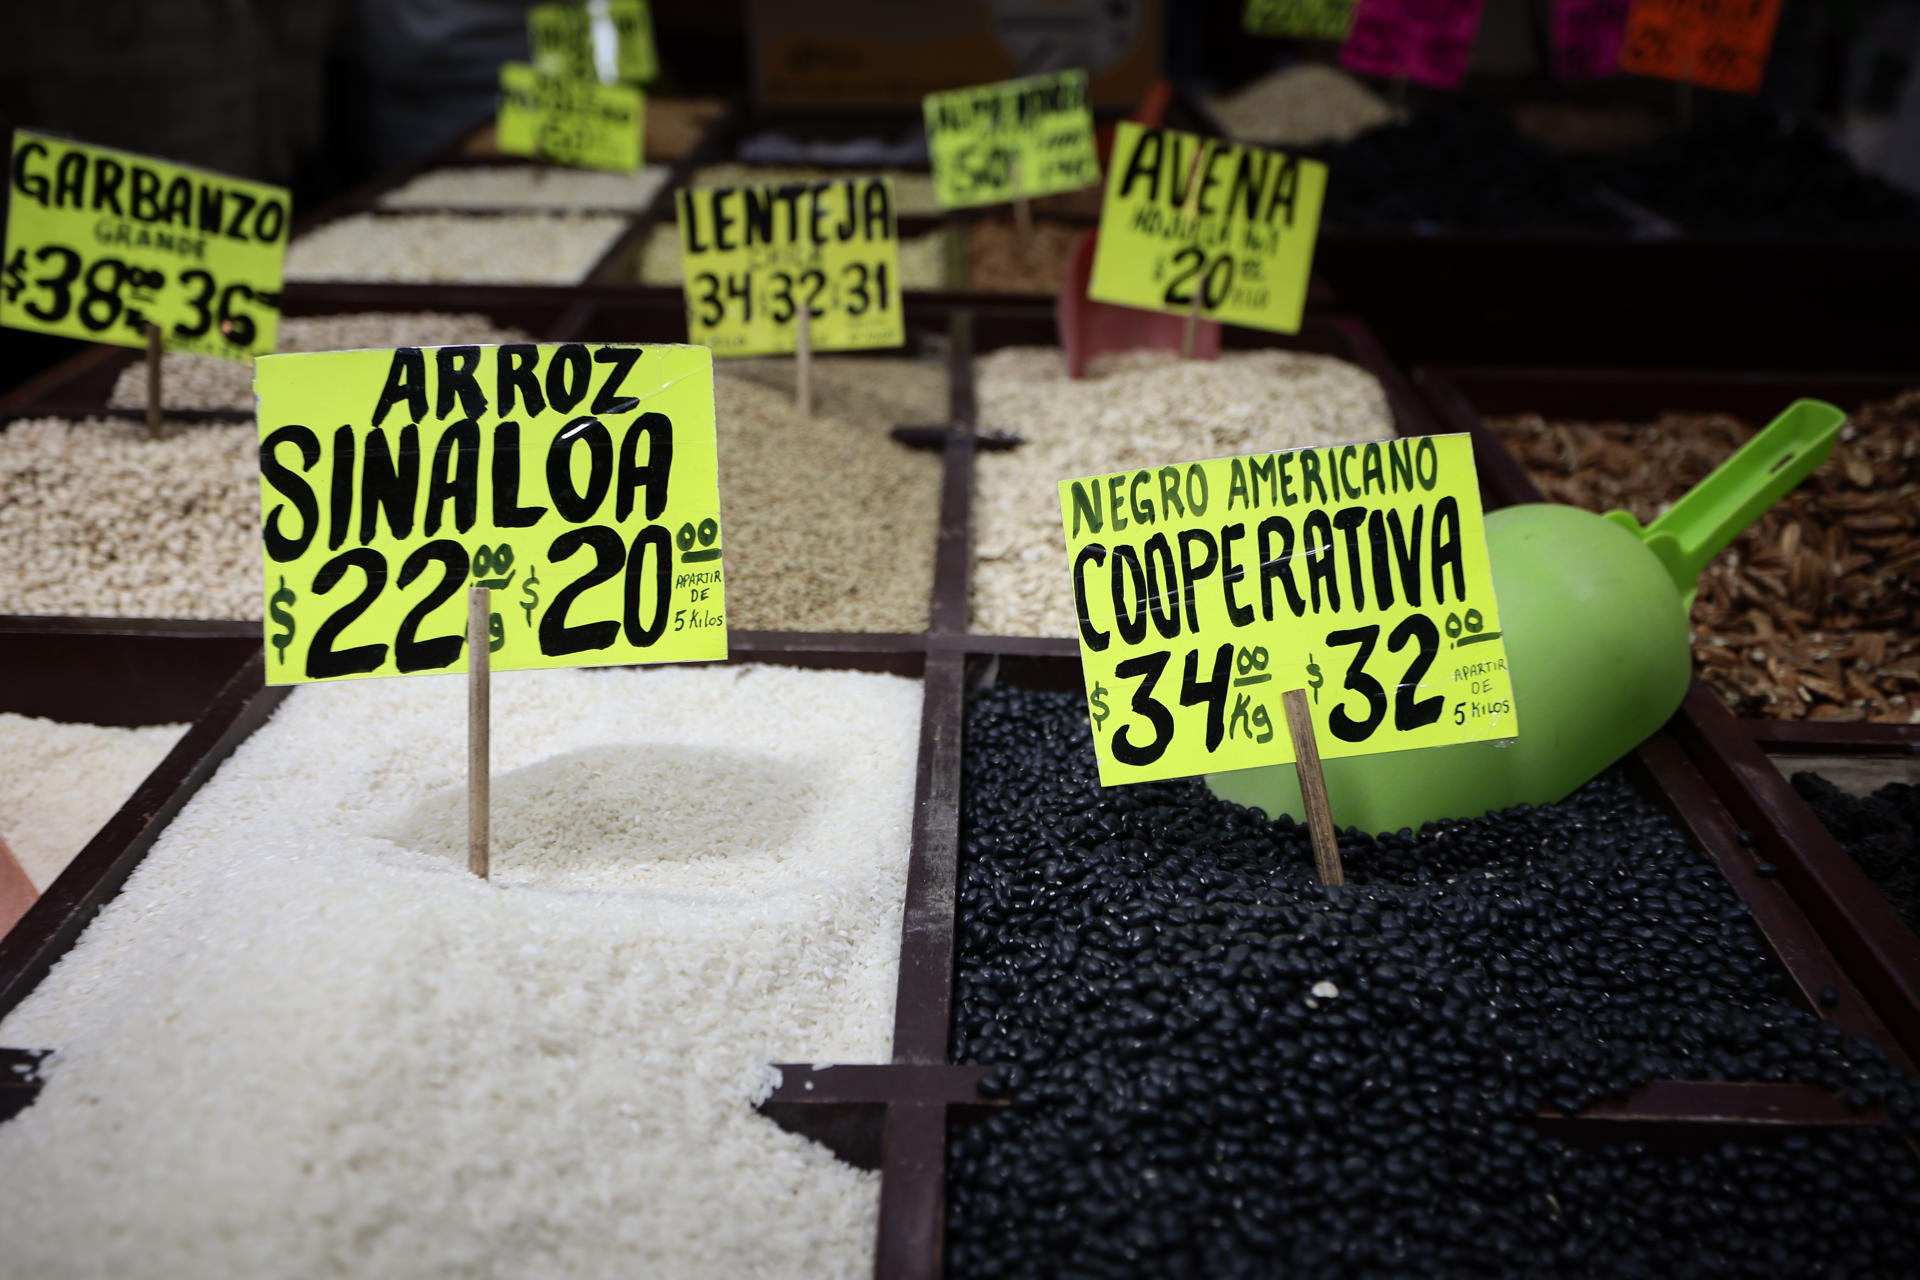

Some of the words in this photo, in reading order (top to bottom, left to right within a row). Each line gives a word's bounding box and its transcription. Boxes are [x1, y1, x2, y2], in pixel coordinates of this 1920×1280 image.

[14, 142, 285, 244] GARBANZO
[684, 178, 890, 255] LENTEJA
[1120, 130, 1300, 244] AVENA
[94, 219, 206, 258] GRANDE
[695, 272, 752, 328] 34
[372, 344, 643, 428] ARROZ
[260, 411, 674, 563] SINALOA
[1071, 464, 1210, 539] NEGRO
[1227, 436, 1438, 512] AMERICANO
[690, 587, 711, 603] DE
[1073, 496, 1466, 652] COOPERATIVA
[674, 609, 688, 632] 5
[1453, 702, 1467, 726] 5
[1470, 700, 1511, 717] KILOS
[1470, 679, 1493, 695] DE
